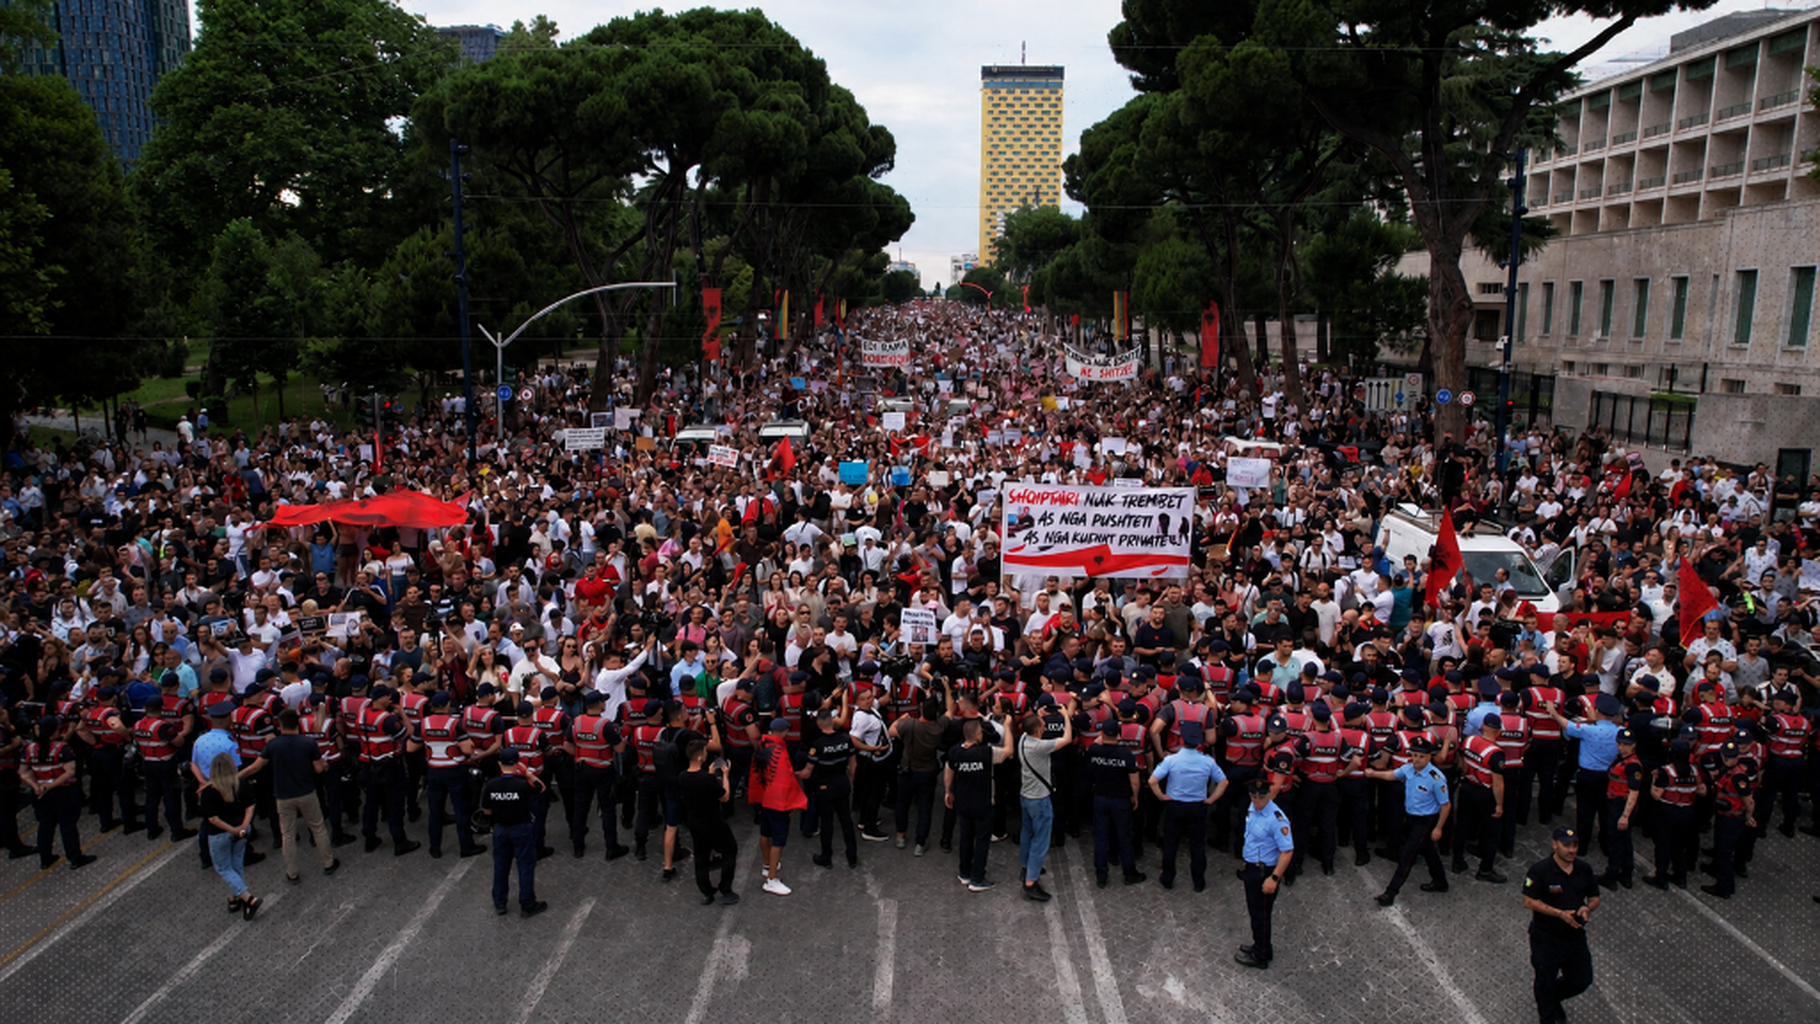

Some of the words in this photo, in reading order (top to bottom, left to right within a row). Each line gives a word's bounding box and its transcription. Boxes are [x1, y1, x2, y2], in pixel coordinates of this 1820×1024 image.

[1084, 492, 1117, 507] NUK
[1121, 493, 1188, 509] TREMBET
[1038, 510, 1055, 527] AS
[1059, 511, 1087, 527] NGA
[1092, 512, 1154, 528] PUSHTETI
[1023, 530, 1039, 545] AS
[1043, 531, 1069, 545] NGA
[1091, 756, 1127, 767] POLICIA
[490, 792, 520, 801] POLICIA
